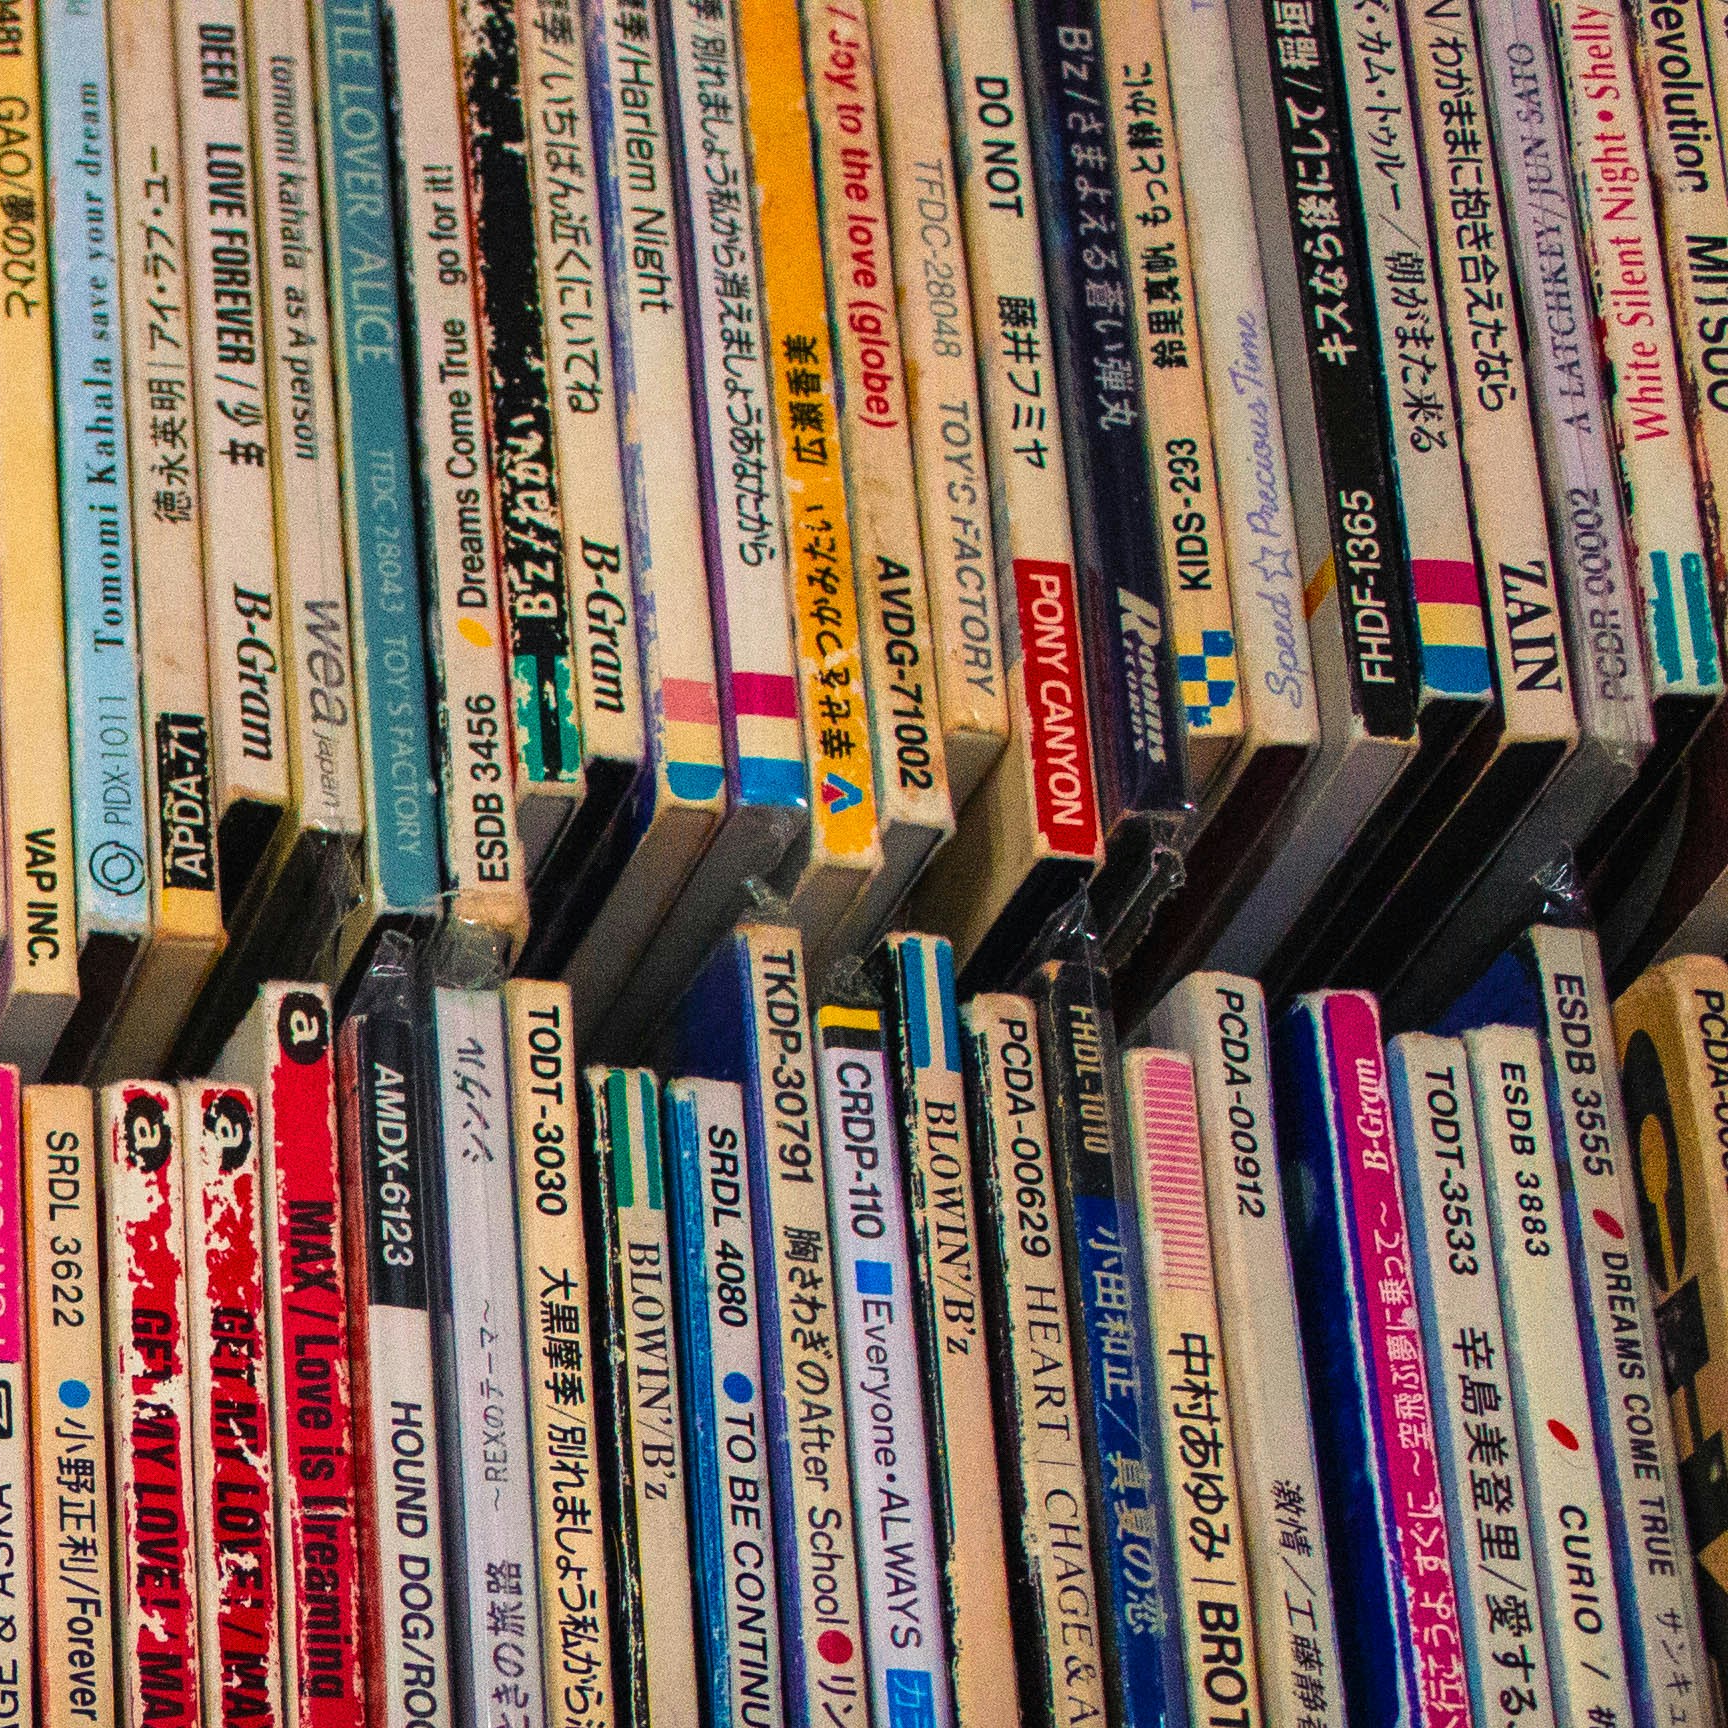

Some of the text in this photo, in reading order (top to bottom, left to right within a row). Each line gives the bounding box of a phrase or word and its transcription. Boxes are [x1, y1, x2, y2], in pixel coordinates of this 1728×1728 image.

[198, 22, 258, 366] DEEN LOVE FOREVER
[973, 74, 1013, 134] DO
[982, 143, 1021, 219] NOT
[88, 505, 126, 653] Tomomi
[1168, 438, 1212, 592] KIDS-233
[1342, 488, 1396, 687] FHDF-1365
[454, 486, 510, 883] ESDB 3456 Dreams
[874, 555, 934, 789] AVDG-71002
[1027, 571, 1067, 659] PONY
[1499, 560, 1561, 694] ZAIN
[169, 724, 206, 878] APDA-71
[1038, 664, 1084, 828] CANYON
[28, 827, 58, 894] VAP
[524, 1005, 568, 1216] TODT-3030
[760, 949, 813, 1183] TKDP-30791
[835, 1058, 883, 1241] CRDP-110
[999, 1016, 1052, 1259] PCDA-00629
[1216, 986, 1265, 1220] PCDA-00912
[371, 1062, 413, 1267] AMDX-6123
[1422, 1065, 1478, 1278] TODT-3533
[1558, 1506, 1605, 1635] CURIO
